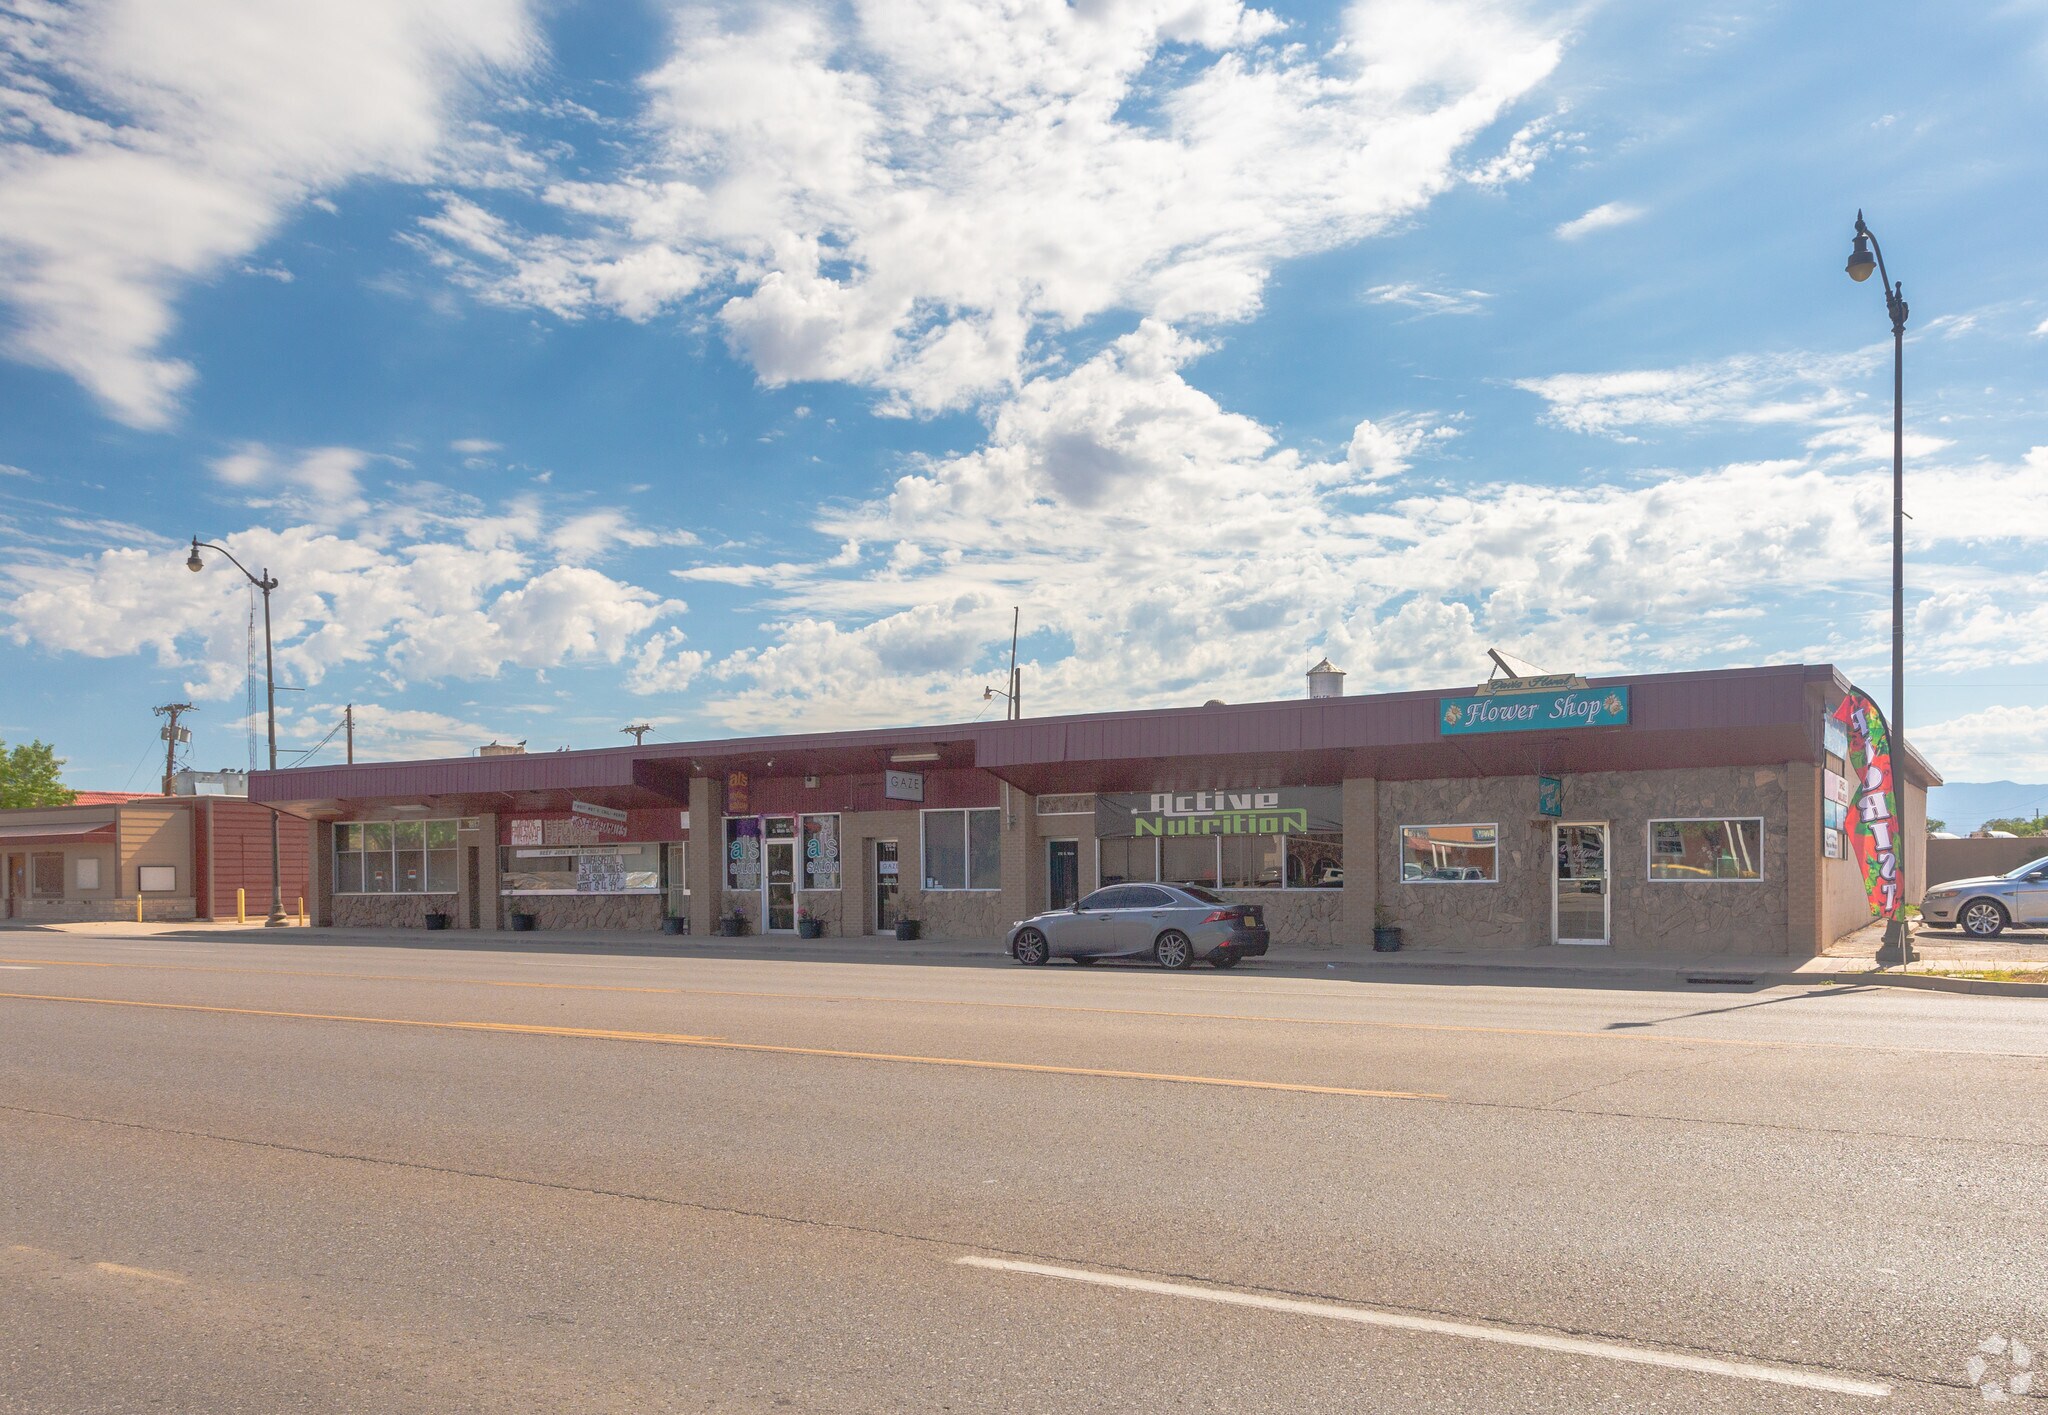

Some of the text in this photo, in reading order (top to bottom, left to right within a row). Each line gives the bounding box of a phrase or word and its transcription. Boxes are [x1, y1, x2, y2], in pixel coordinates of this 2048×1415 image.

[1464, 693, 1602, 727] Flower Shop
[890, 776, 920, 790] GAZE
[1150, 791, 1279, 814] Active
[729, 862, 761, 875] SALON
[806, 861, 839, 874] SALON
[882, 862, 898, 870] GAZ
